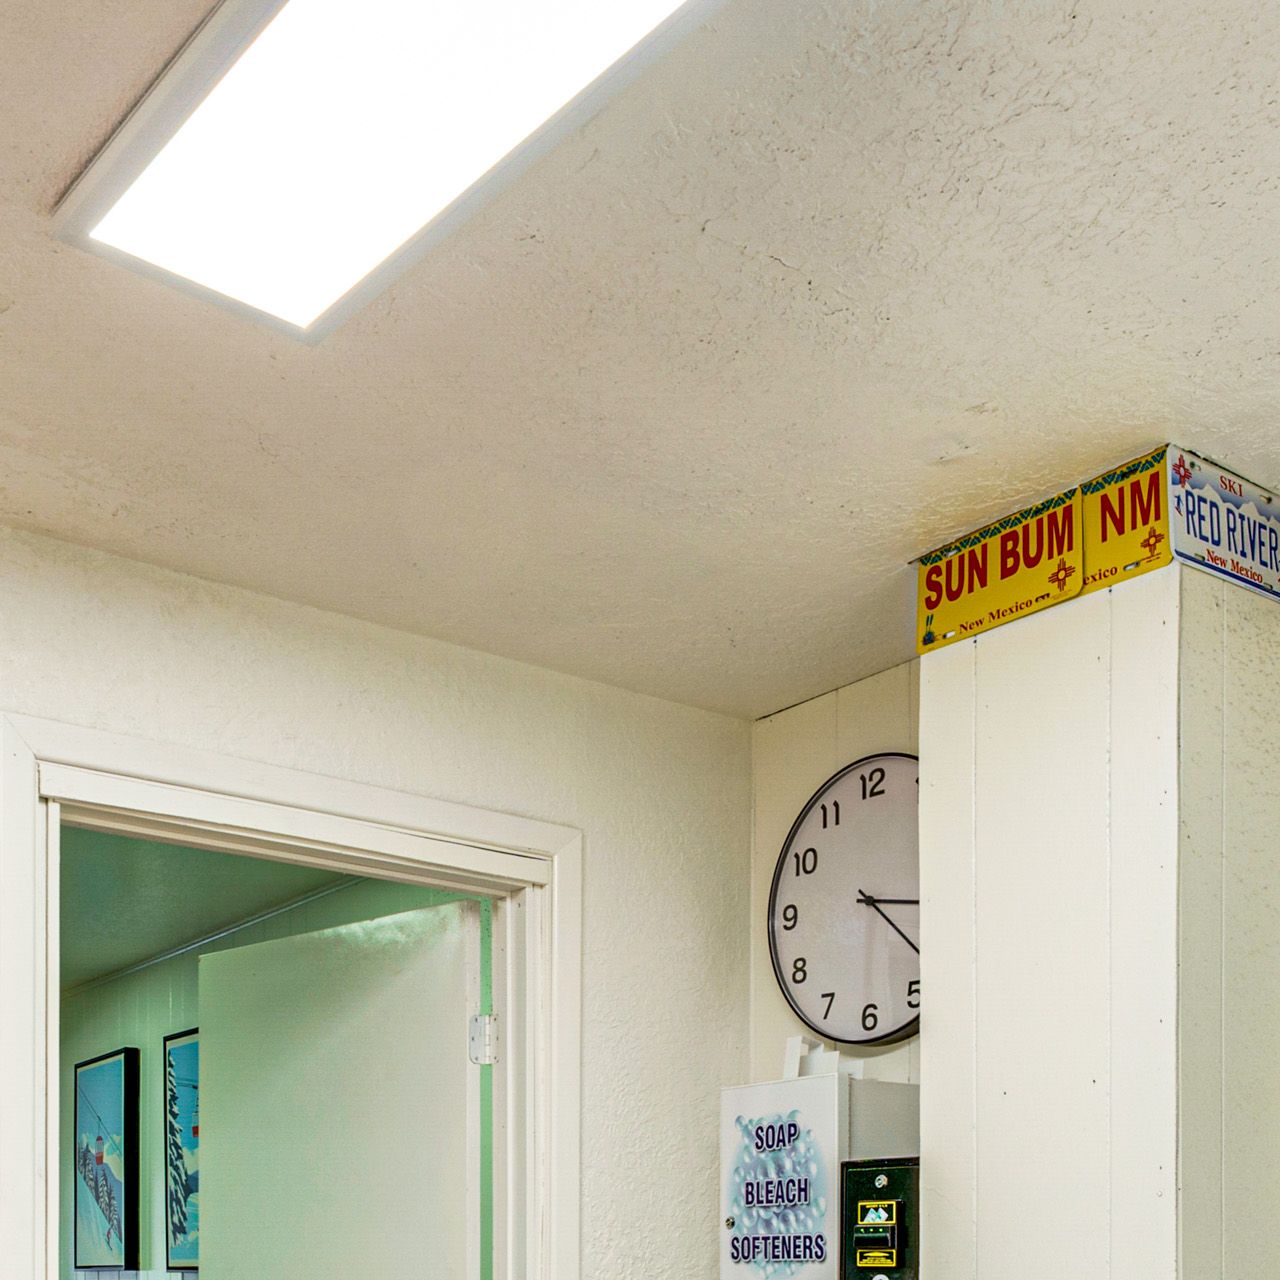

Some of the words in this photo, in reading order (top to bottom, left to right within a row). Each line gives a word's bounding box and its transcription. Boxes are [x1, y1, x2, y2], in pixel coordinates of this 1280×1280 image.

[1220, 474, 1245, 498] SKI
[1100, 470, 1162, 544] NM
[1184, 489, 1222, 548] RED
[1226, 506, 1280, 574] RIVER
[925, 543, 989, 611] SUN
[1000, 504, 1074, 581] BUM
[1205, 548, 1228, 569] New
[1230, 558, 1264, 584] Mexico
[1083, 565, 1118, 586] exico
[959, 617, 985, 634] New
[987, 598, 1033, 623] Mexico
[859, 767, 886, 801] 12
[820, 799, 841, 830] 11
[793, 847, 819, 877] 10
[782, 904, 799, 931] 9
[791, 957, 808, 985] 8
[820, 991, 836, 1020] 7
[906, 979, 920, 1009] 5
[860, 1002, 879, 1031] 6
[755, 1122, 799, 1151] SOAP
[744, 1177, 809, 1206] BLEACH
[730, 1233, 826, 1262] SOFTENERS
